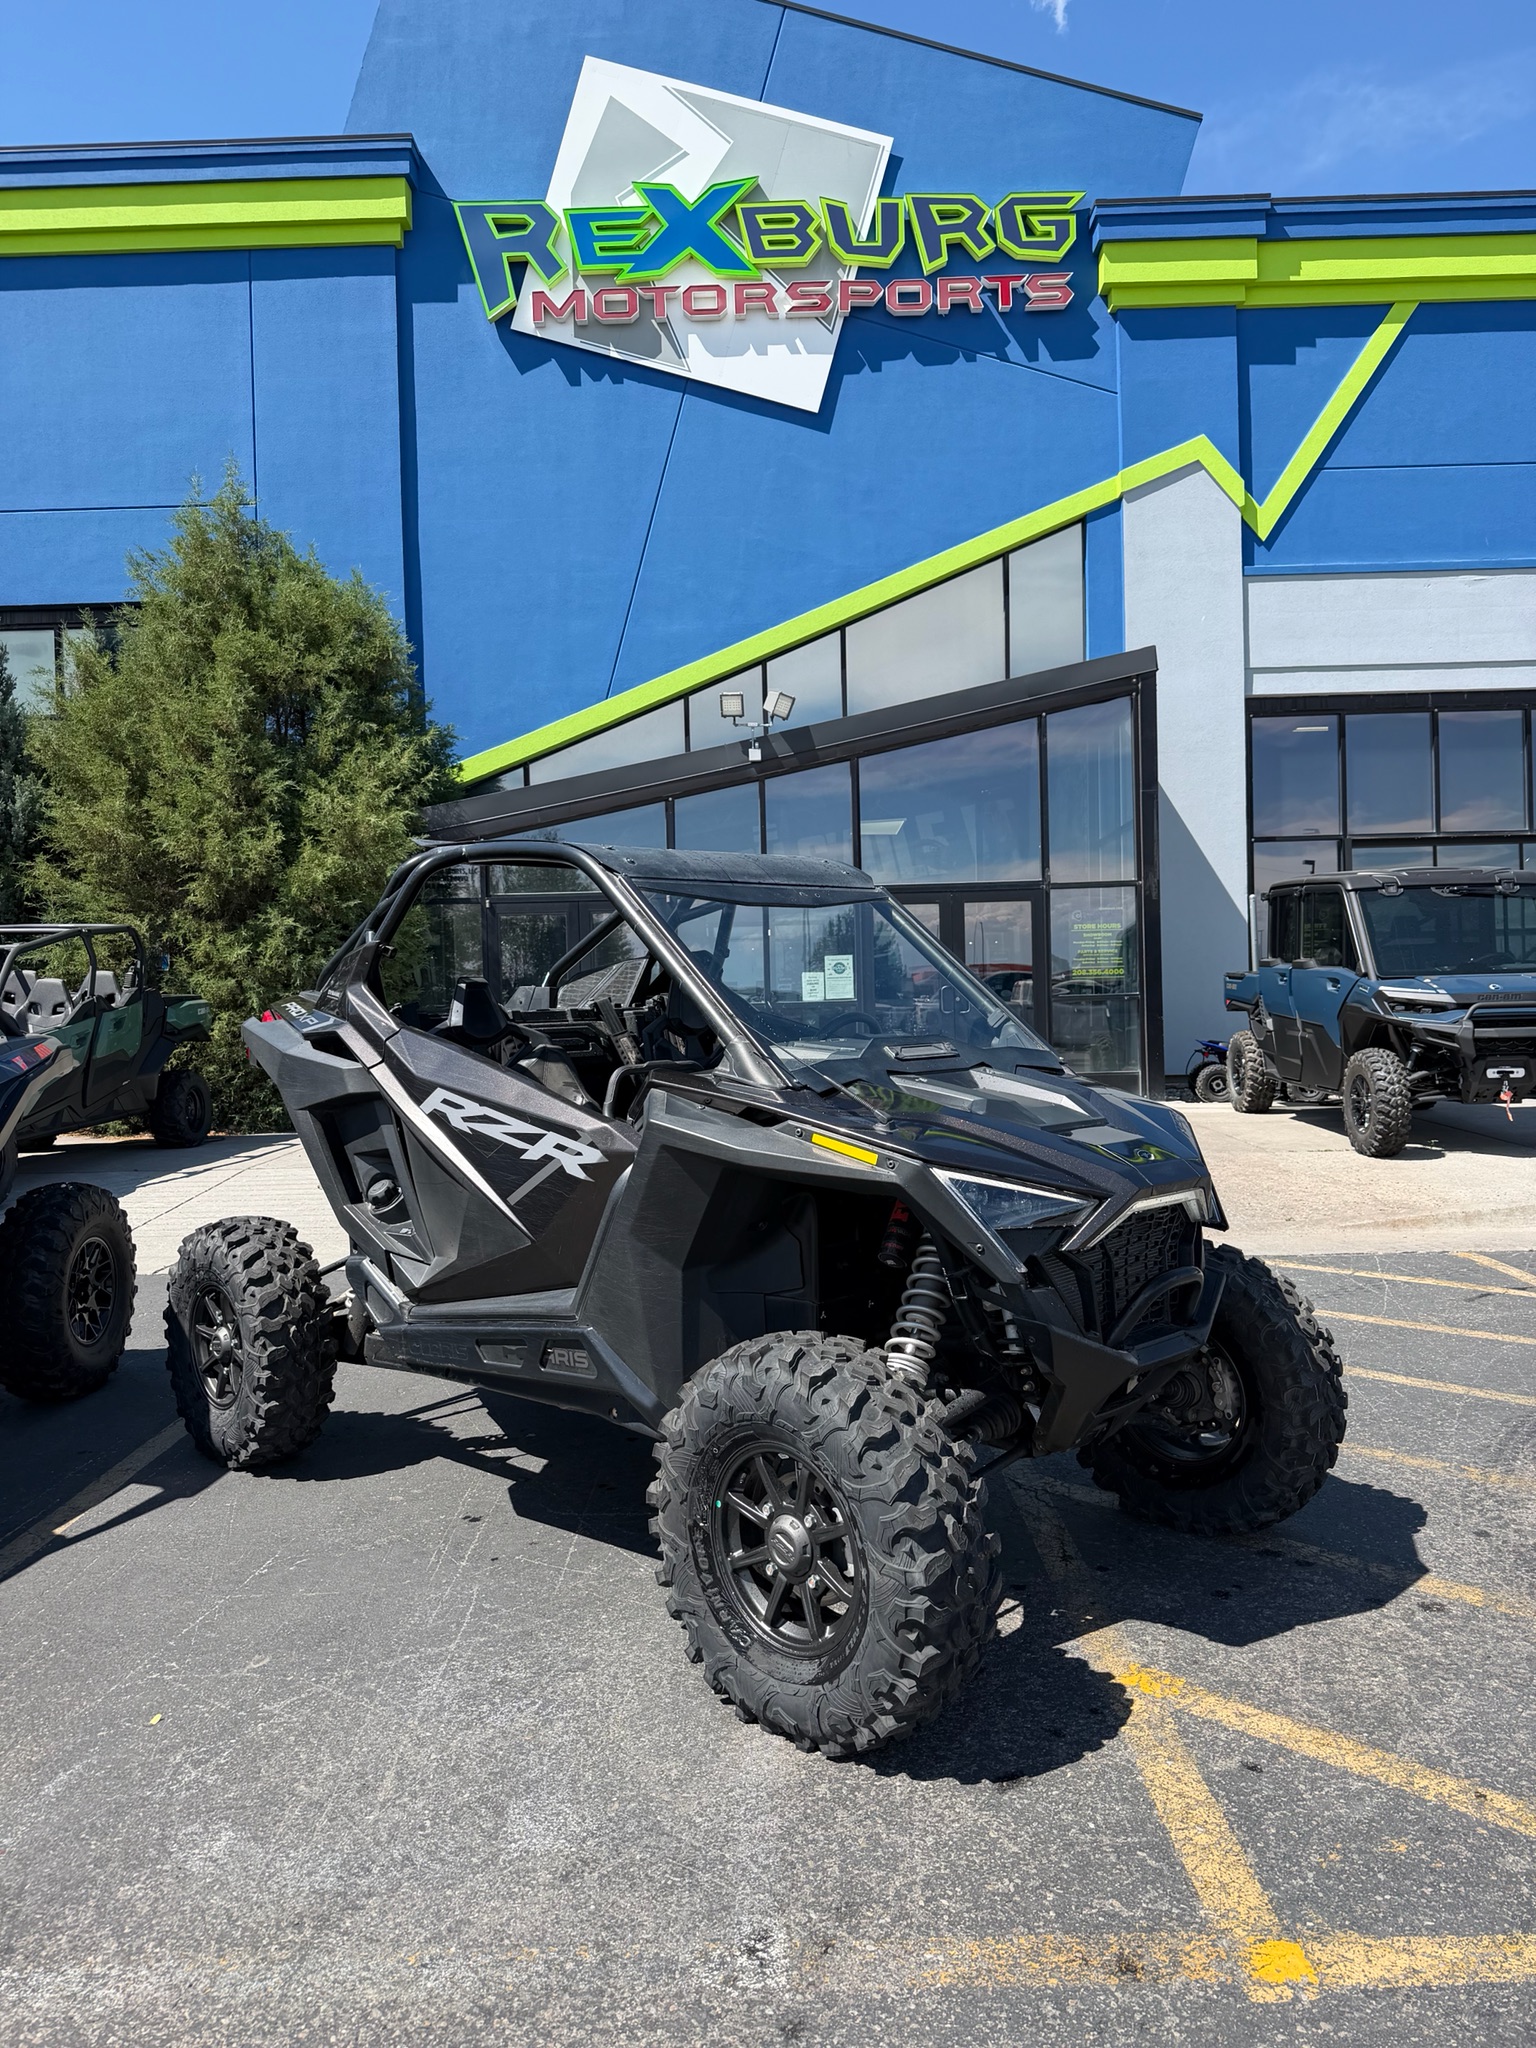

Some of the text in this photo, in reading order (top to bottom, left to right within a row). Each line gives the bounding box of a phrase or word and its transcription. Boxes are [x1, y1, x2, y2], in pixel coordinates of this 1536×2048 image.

[453, 175, 1086, 322] REXBURG
[531, 271, 1075, 328] MOTORSPORTS
[420, 1087, 609, 1182] RZR
